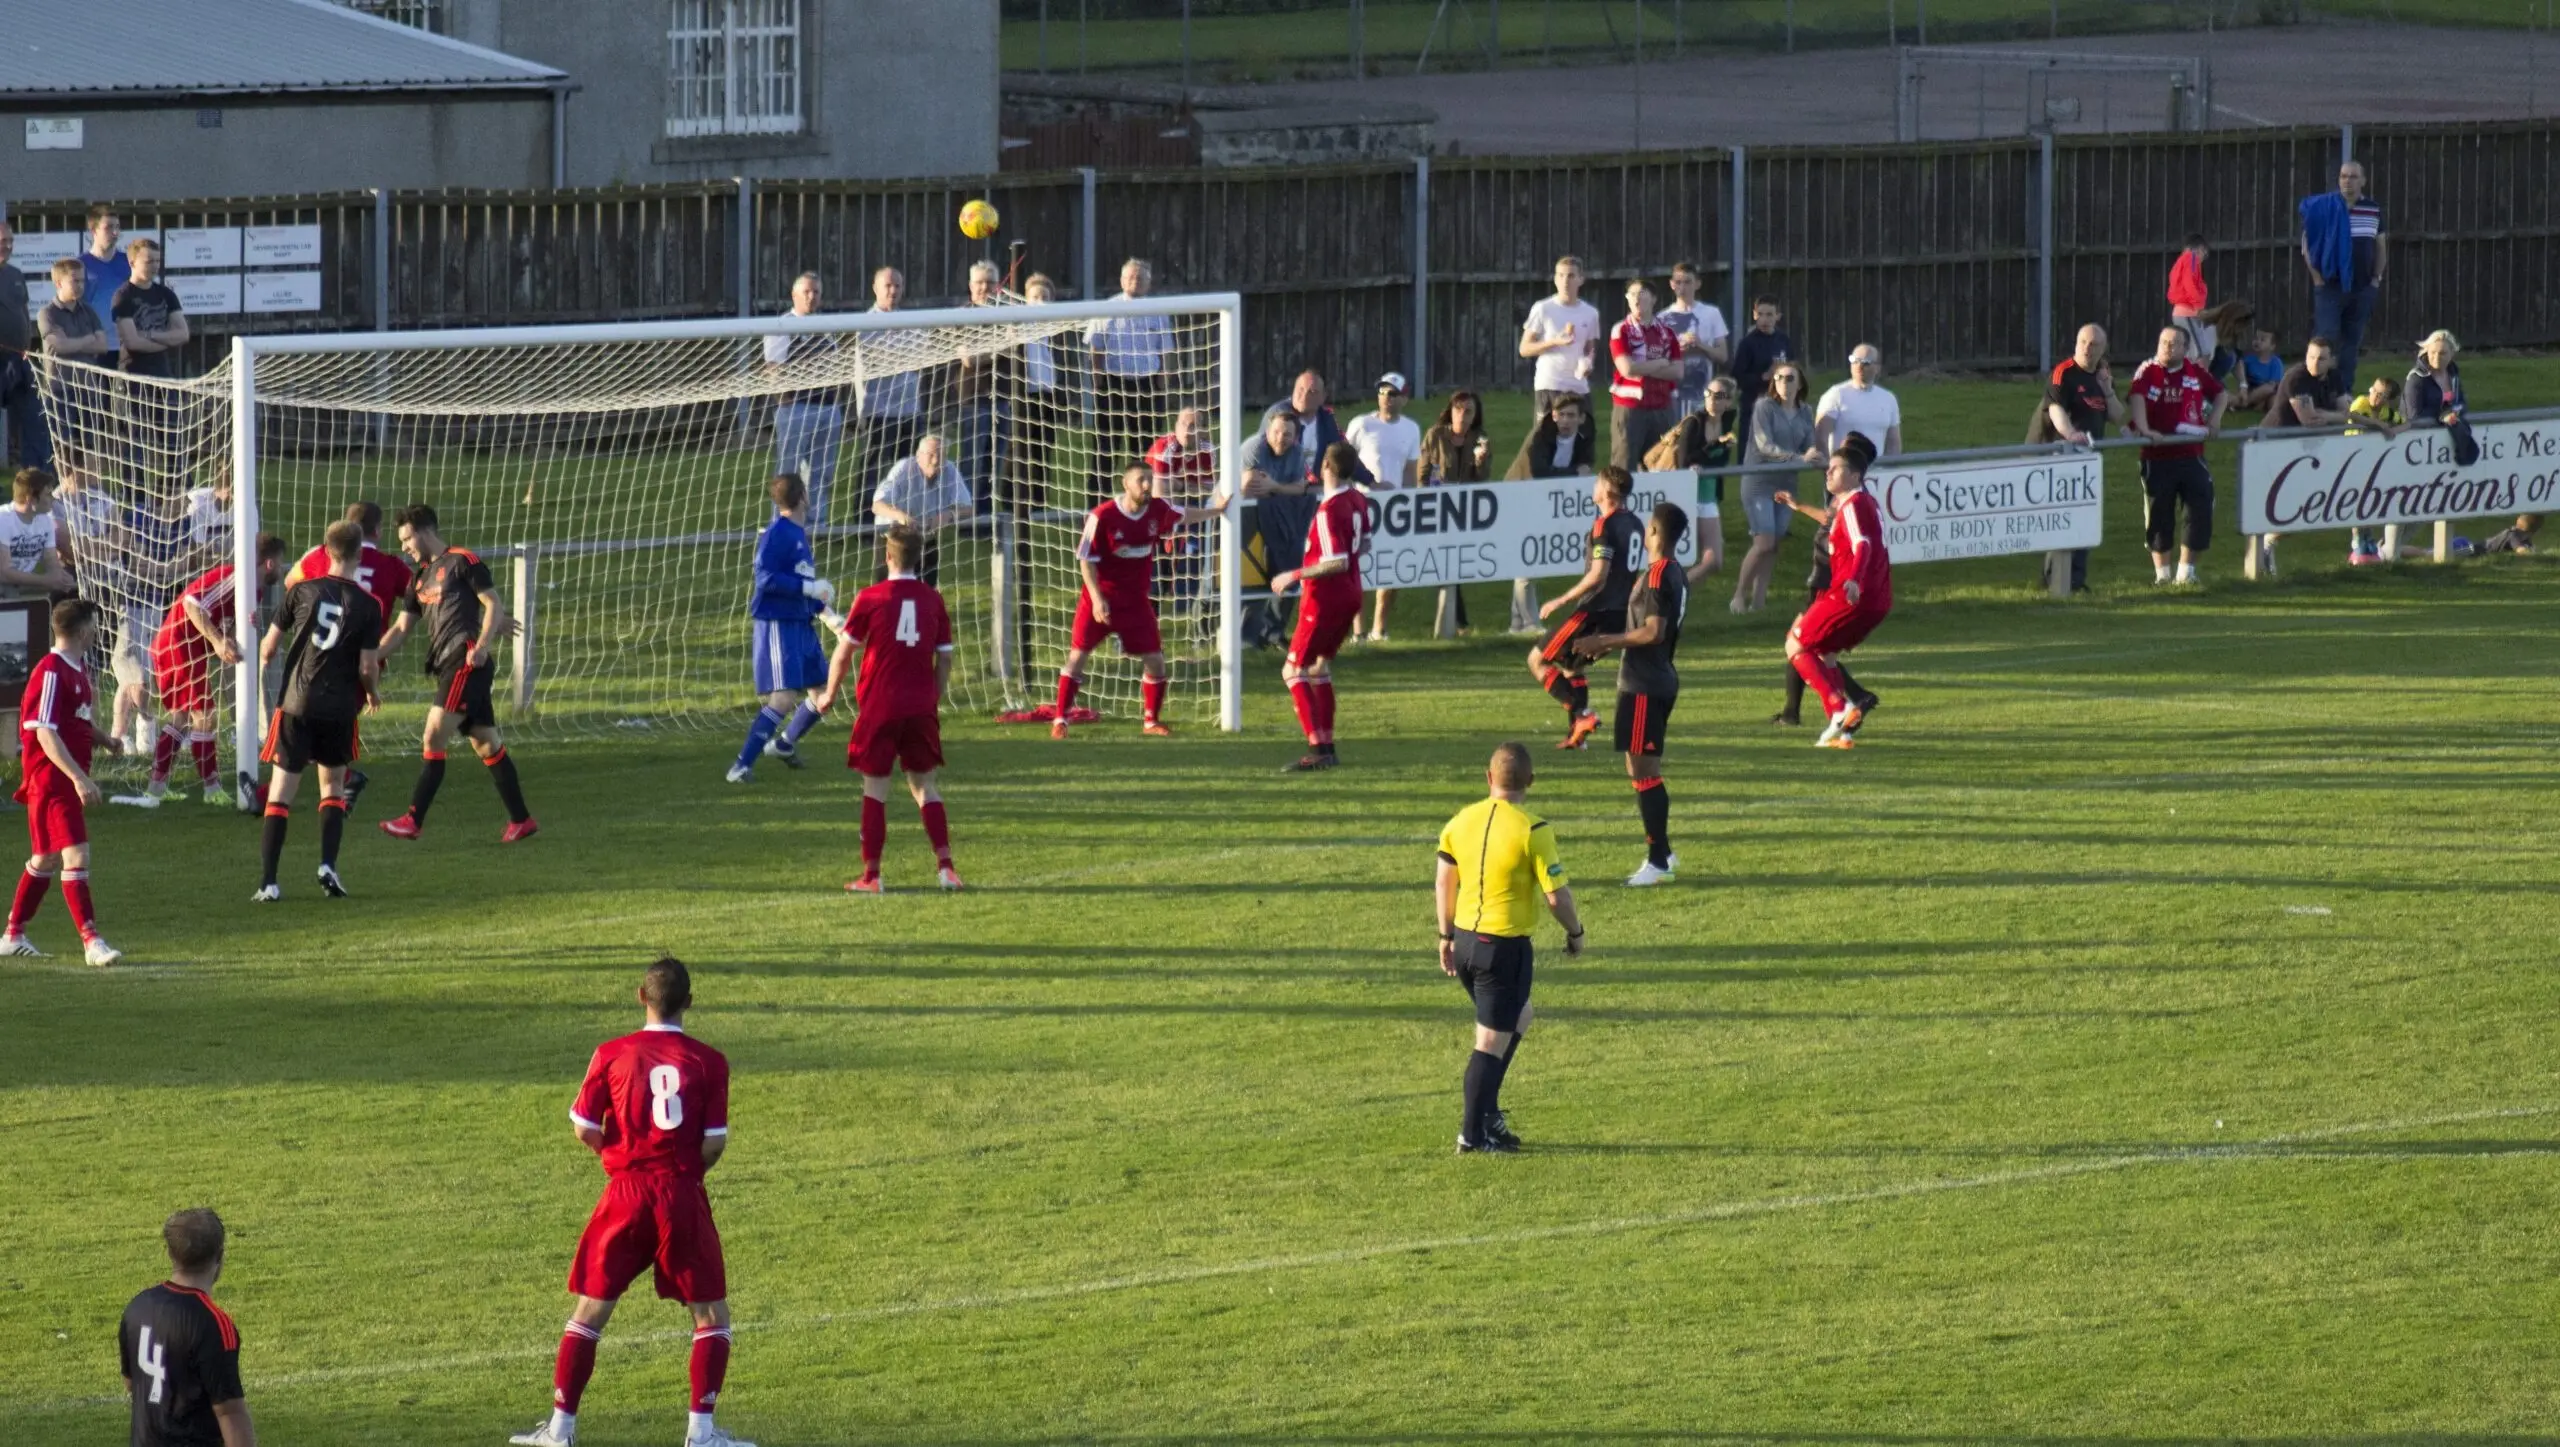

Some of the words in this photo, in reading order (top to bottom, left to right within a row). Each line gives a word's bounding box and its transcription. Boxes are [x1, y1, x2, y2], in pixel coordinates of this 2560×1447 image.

[2405, 436, 2504, 466] Claic
[1925, 477, 2015, 514] Steven
[2024, 465, 2097, 505] Clark
[2264, 446, 2519, 527] Celebrations
[2527, 469, 2560, 502] of
[1521, 532, 1589, 567] 0188
[1950, 519, 1997, 541] BODY
[2005, 512, 2071, 535] REPAIRS
[1626, 531, 1642, 573] 8
[312, 601, 343, 651] 5
[895, 599, 920, 647] 4
[649, 1064, 683, 1131] 8
[137, 1325, 167, 1404] 4
